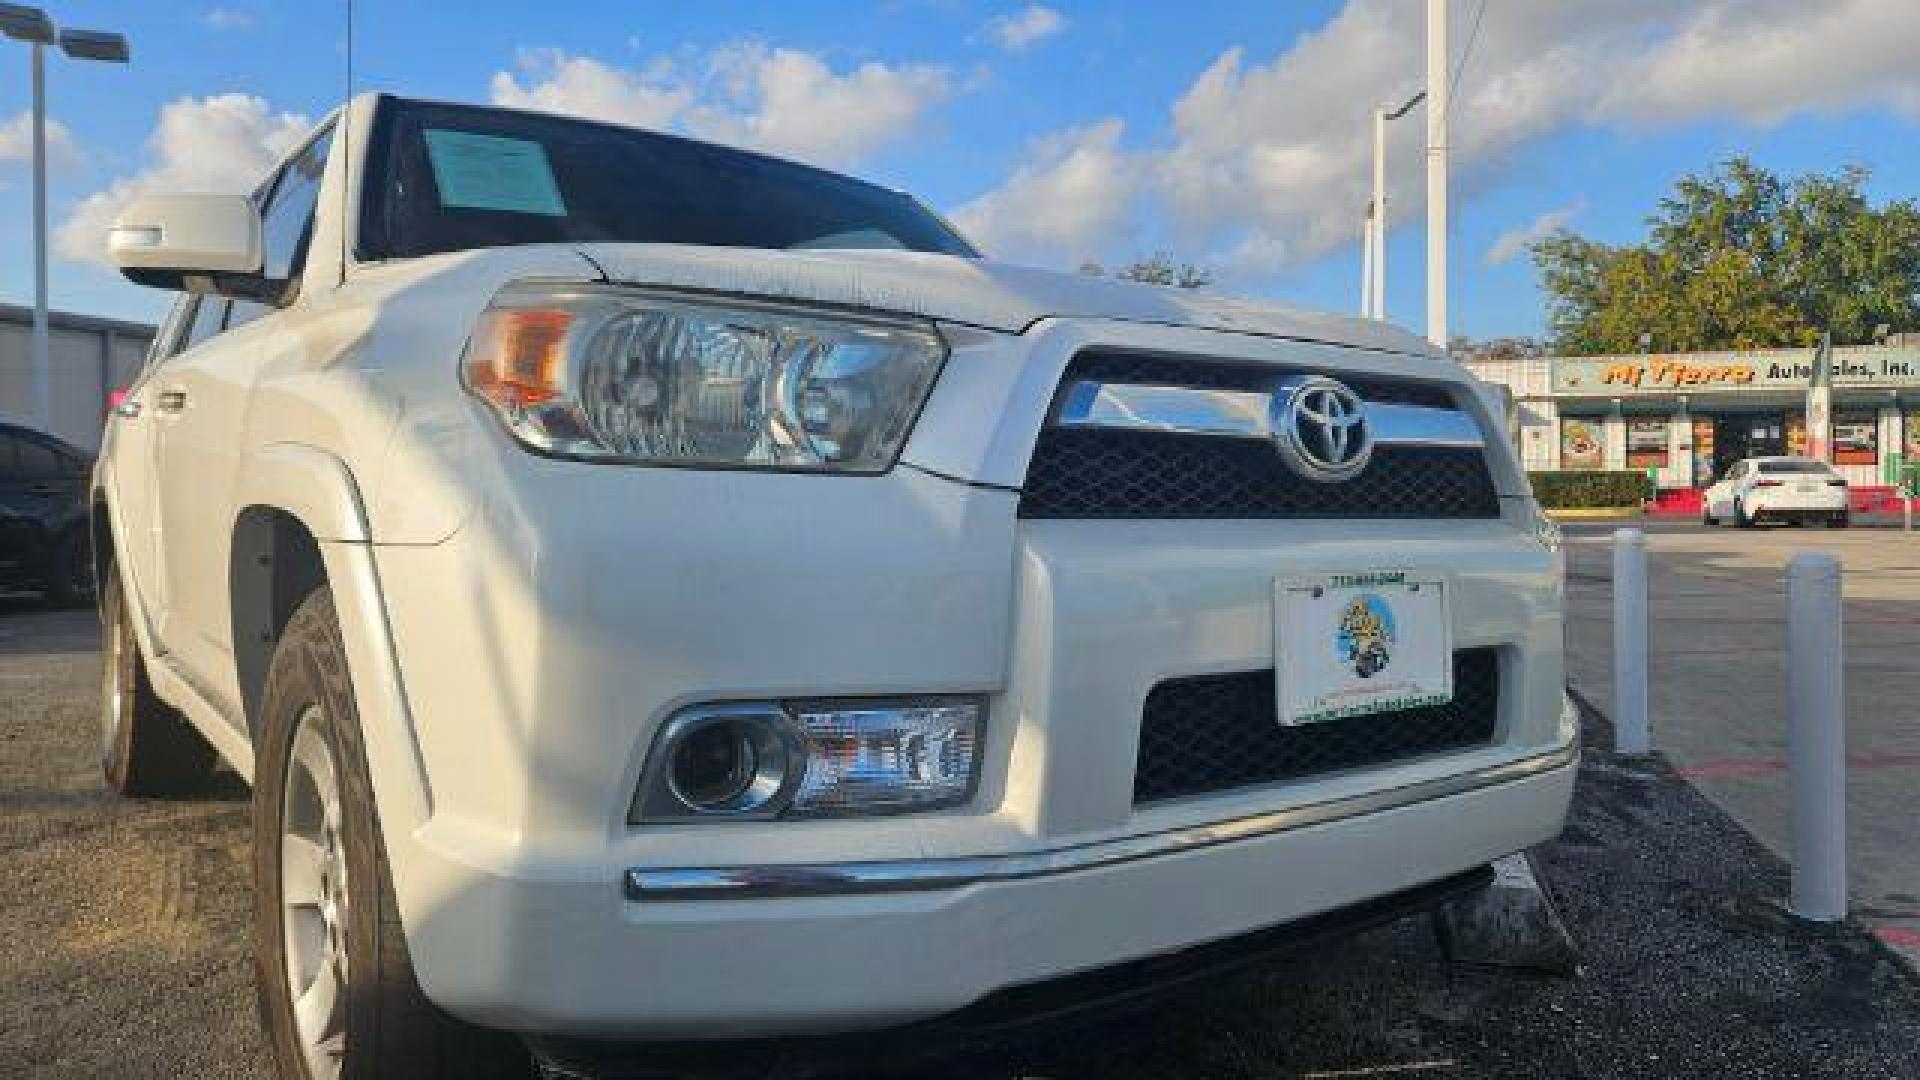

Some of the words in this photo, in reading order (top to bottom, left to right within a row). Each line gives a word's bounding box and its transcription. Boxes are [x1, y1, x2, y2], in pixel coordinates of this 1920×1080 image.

[1767, 361, 1813, 379] Auto
[1823, 359, 1876, 380] ales,
[1880, 359, 1915, 377] Inc.
